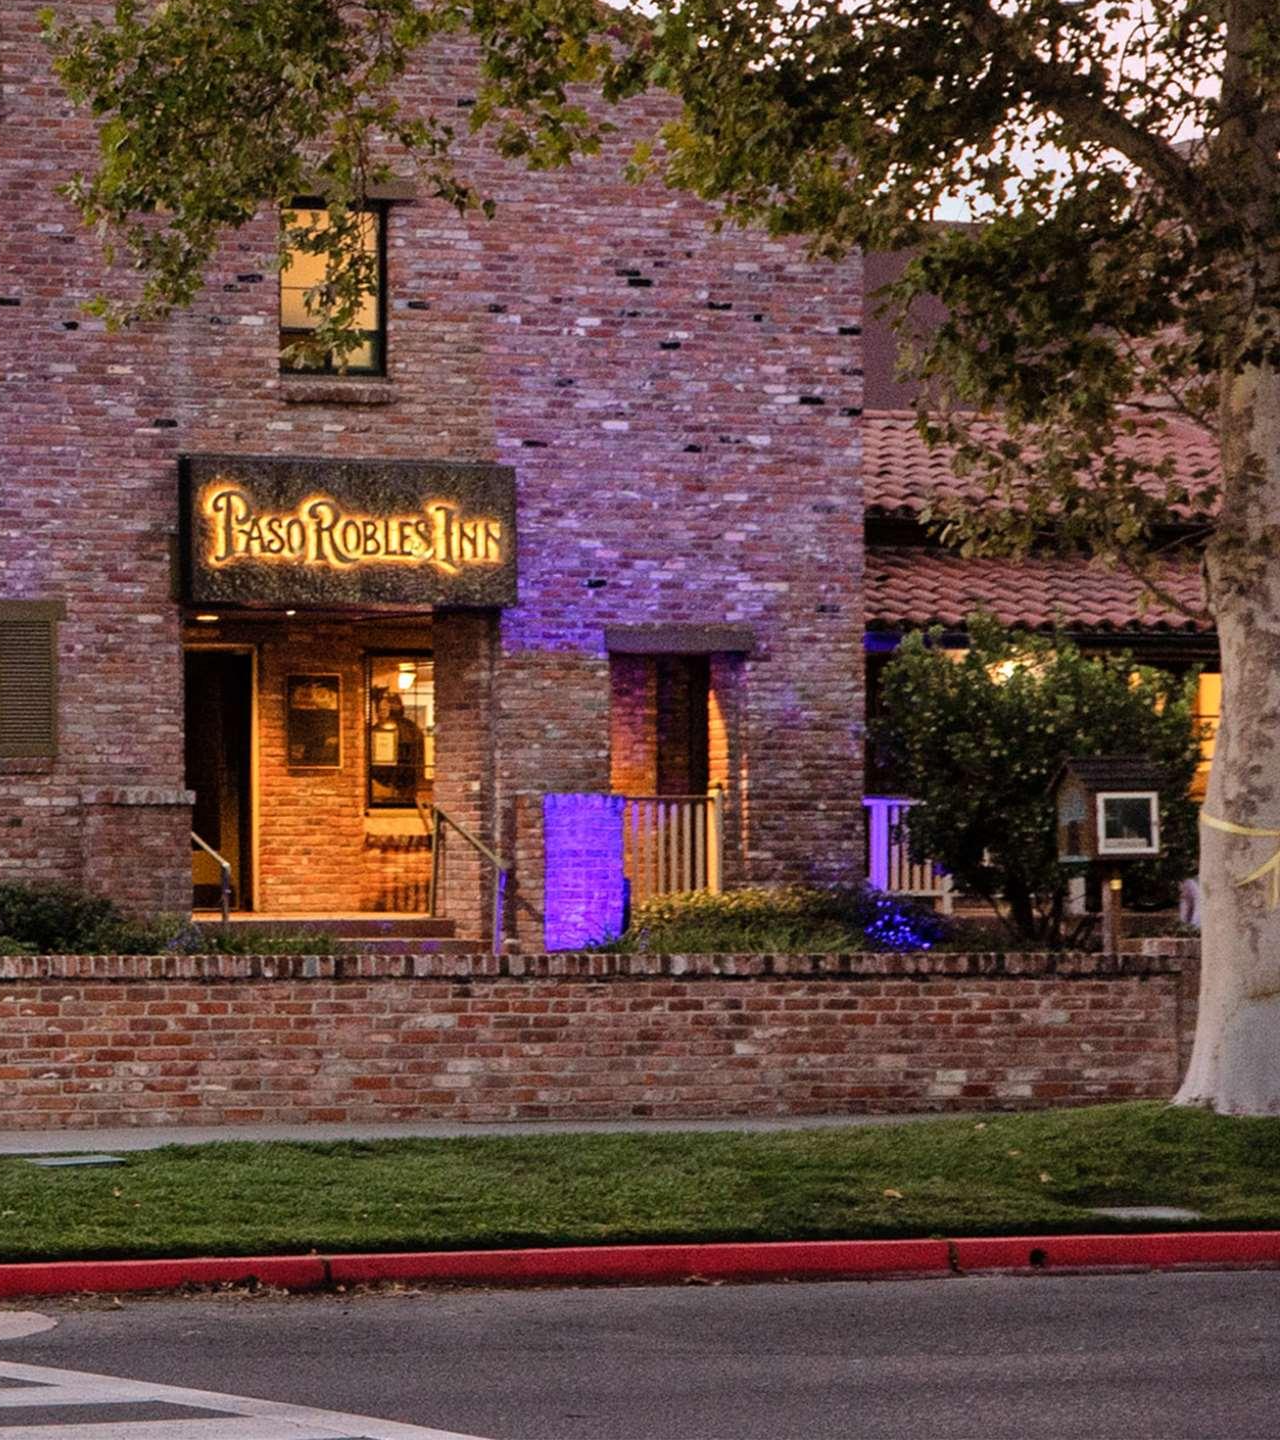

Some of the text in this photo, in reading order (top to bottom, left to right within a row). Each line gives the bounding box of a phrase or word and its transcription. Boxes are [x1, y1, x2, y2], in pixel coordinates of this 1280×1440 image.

[212, 490, 500, 565] PASO ROBLES INN
